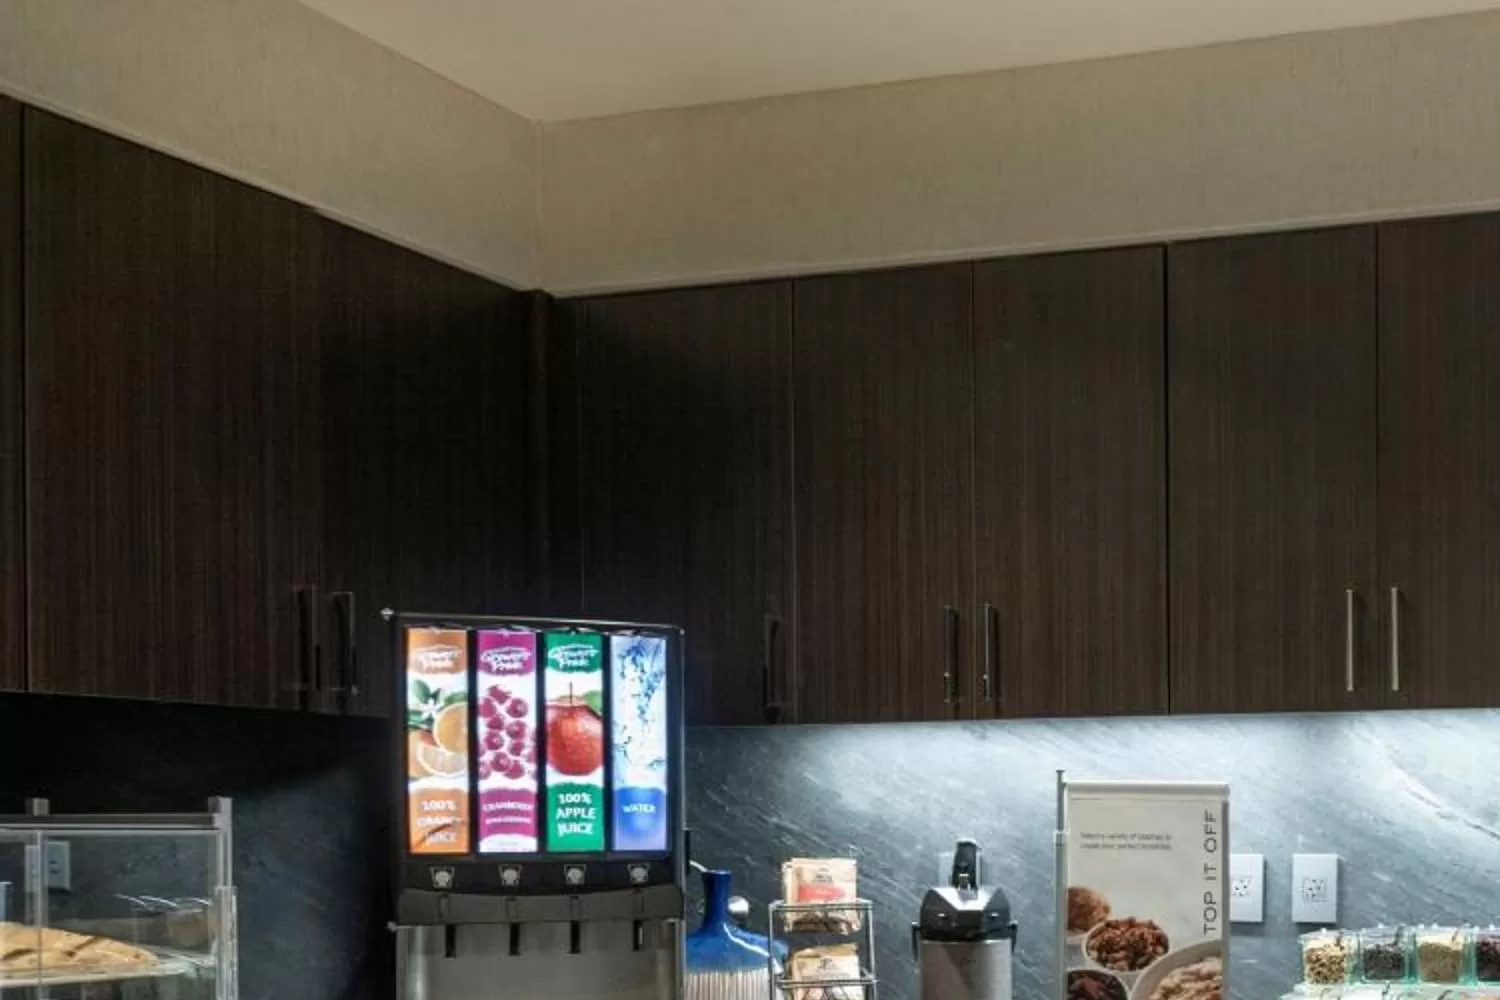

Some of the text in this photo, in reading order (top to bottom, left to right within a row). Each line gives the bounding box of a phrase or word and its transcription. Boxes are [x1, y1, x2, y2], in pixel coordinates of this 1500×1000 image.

[558, 792, 593, 804] 100%
[556, 807, 597, 820] APPLE
[622, 803, 657, 813] WATER
[557, 823, 593, 837] JUICE
[1204, 809, 1217, 935] TOP IT OFF
